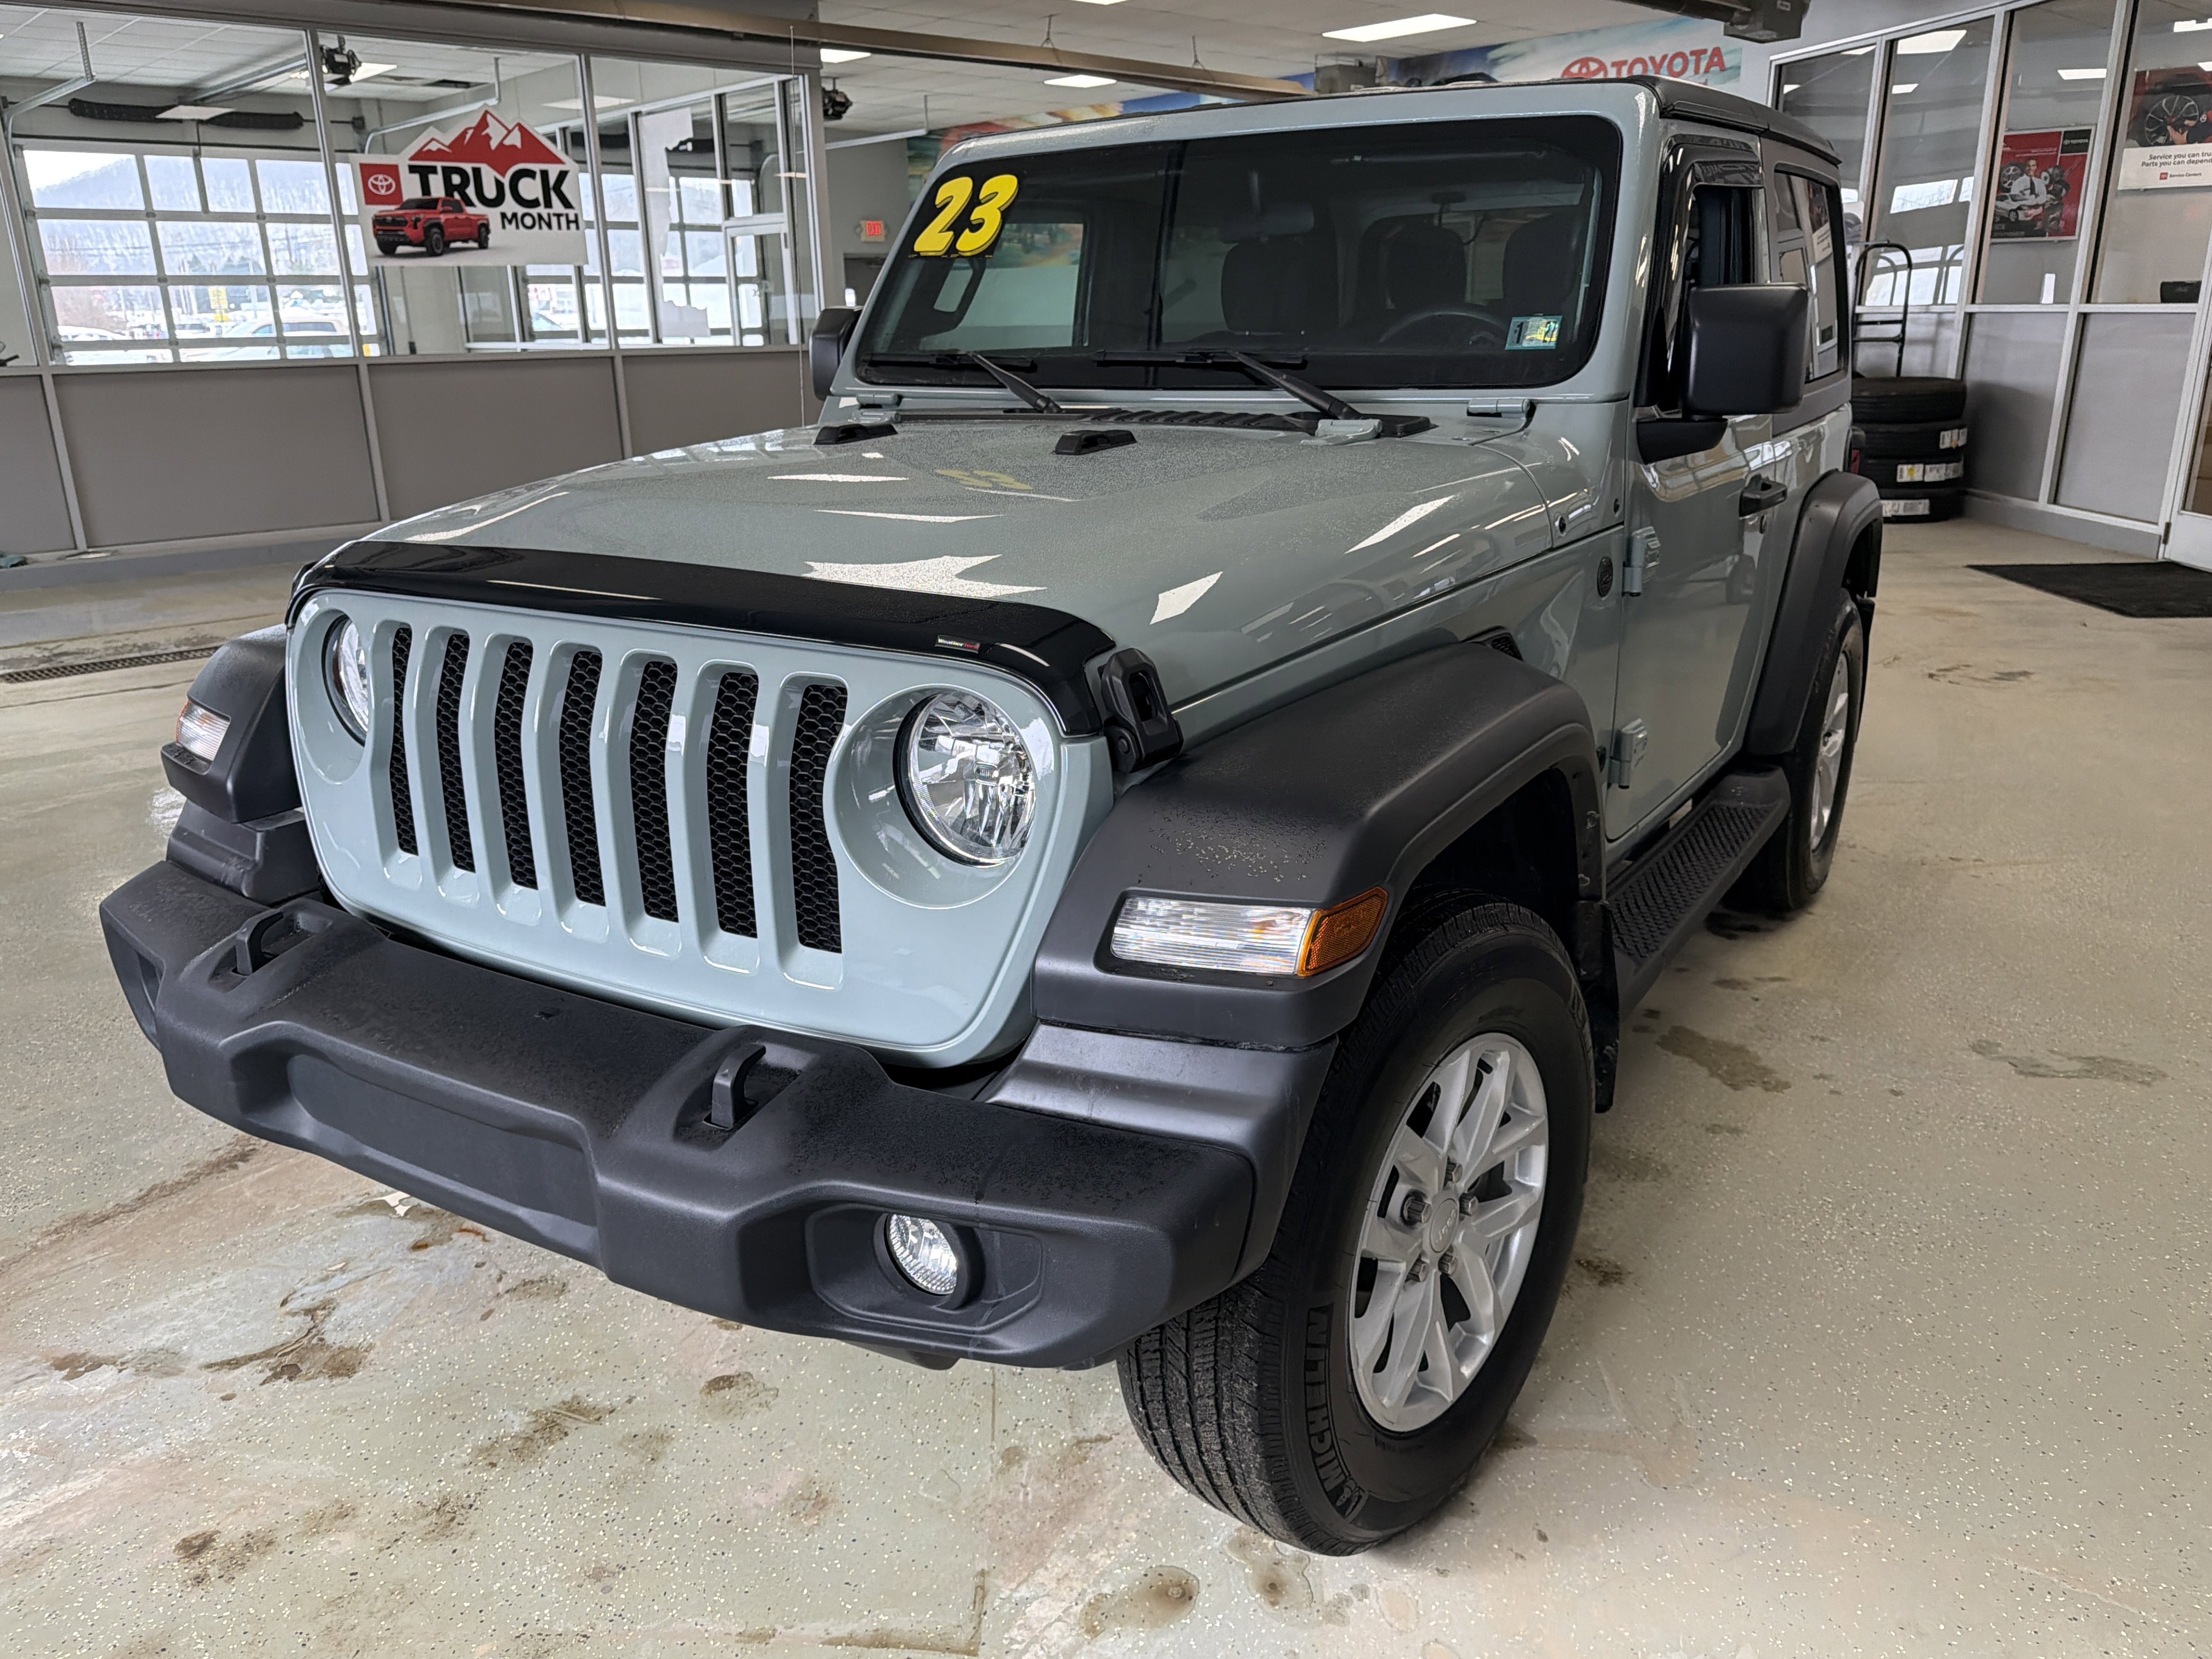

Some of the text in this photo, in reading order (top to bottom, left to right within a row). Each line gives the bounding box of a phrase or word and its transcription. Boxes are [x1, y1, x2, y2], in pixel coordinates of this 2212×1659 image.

[1611, 46, 1726, 78] TOYOTA
[408, 164, 575, 210] TRUCK
[500, 211, 580, 230] MONTH
[913, 174, 1019, 256] 23
[1516, 321, 1524, 344] 1
[1305, 1307, 1345, 1492] MICHELIN
